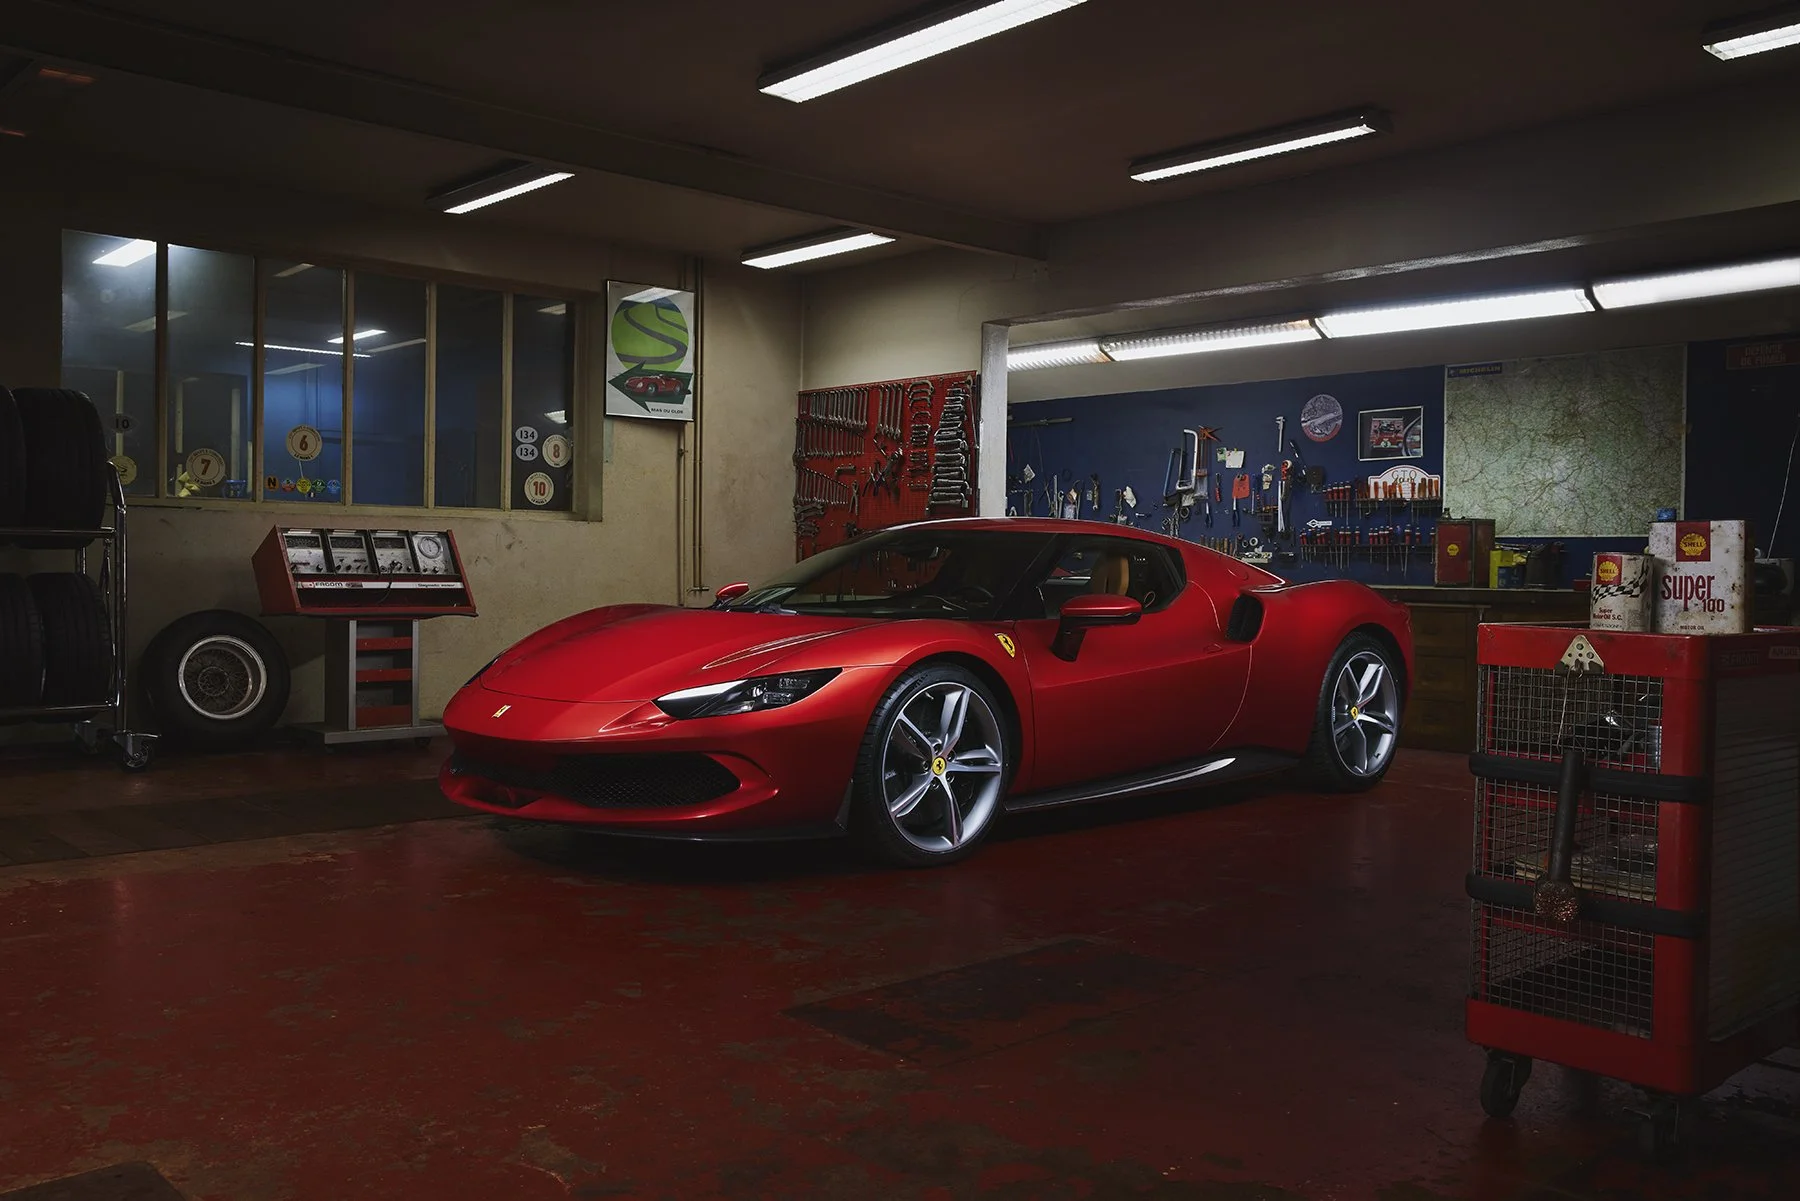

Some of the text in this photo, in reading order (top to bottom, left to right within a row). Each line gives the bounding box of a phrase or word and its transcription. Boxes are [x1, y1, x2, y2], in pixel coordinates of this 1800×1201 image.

[520, 430, 535, 439] 134
[299, 434, 309, 451] 6
[520, 448, 535, 457] 134
[553, 443, 560, 459] 8
[201, 458, 211, 475] 7
[1391, 469, 1417, 480] GTO
[267, 477, 277, 488] N
[533, 481, 546, 497] 10
[1661, 575, 1715, 611] super
[1702, 599, 1725, 613] 100
